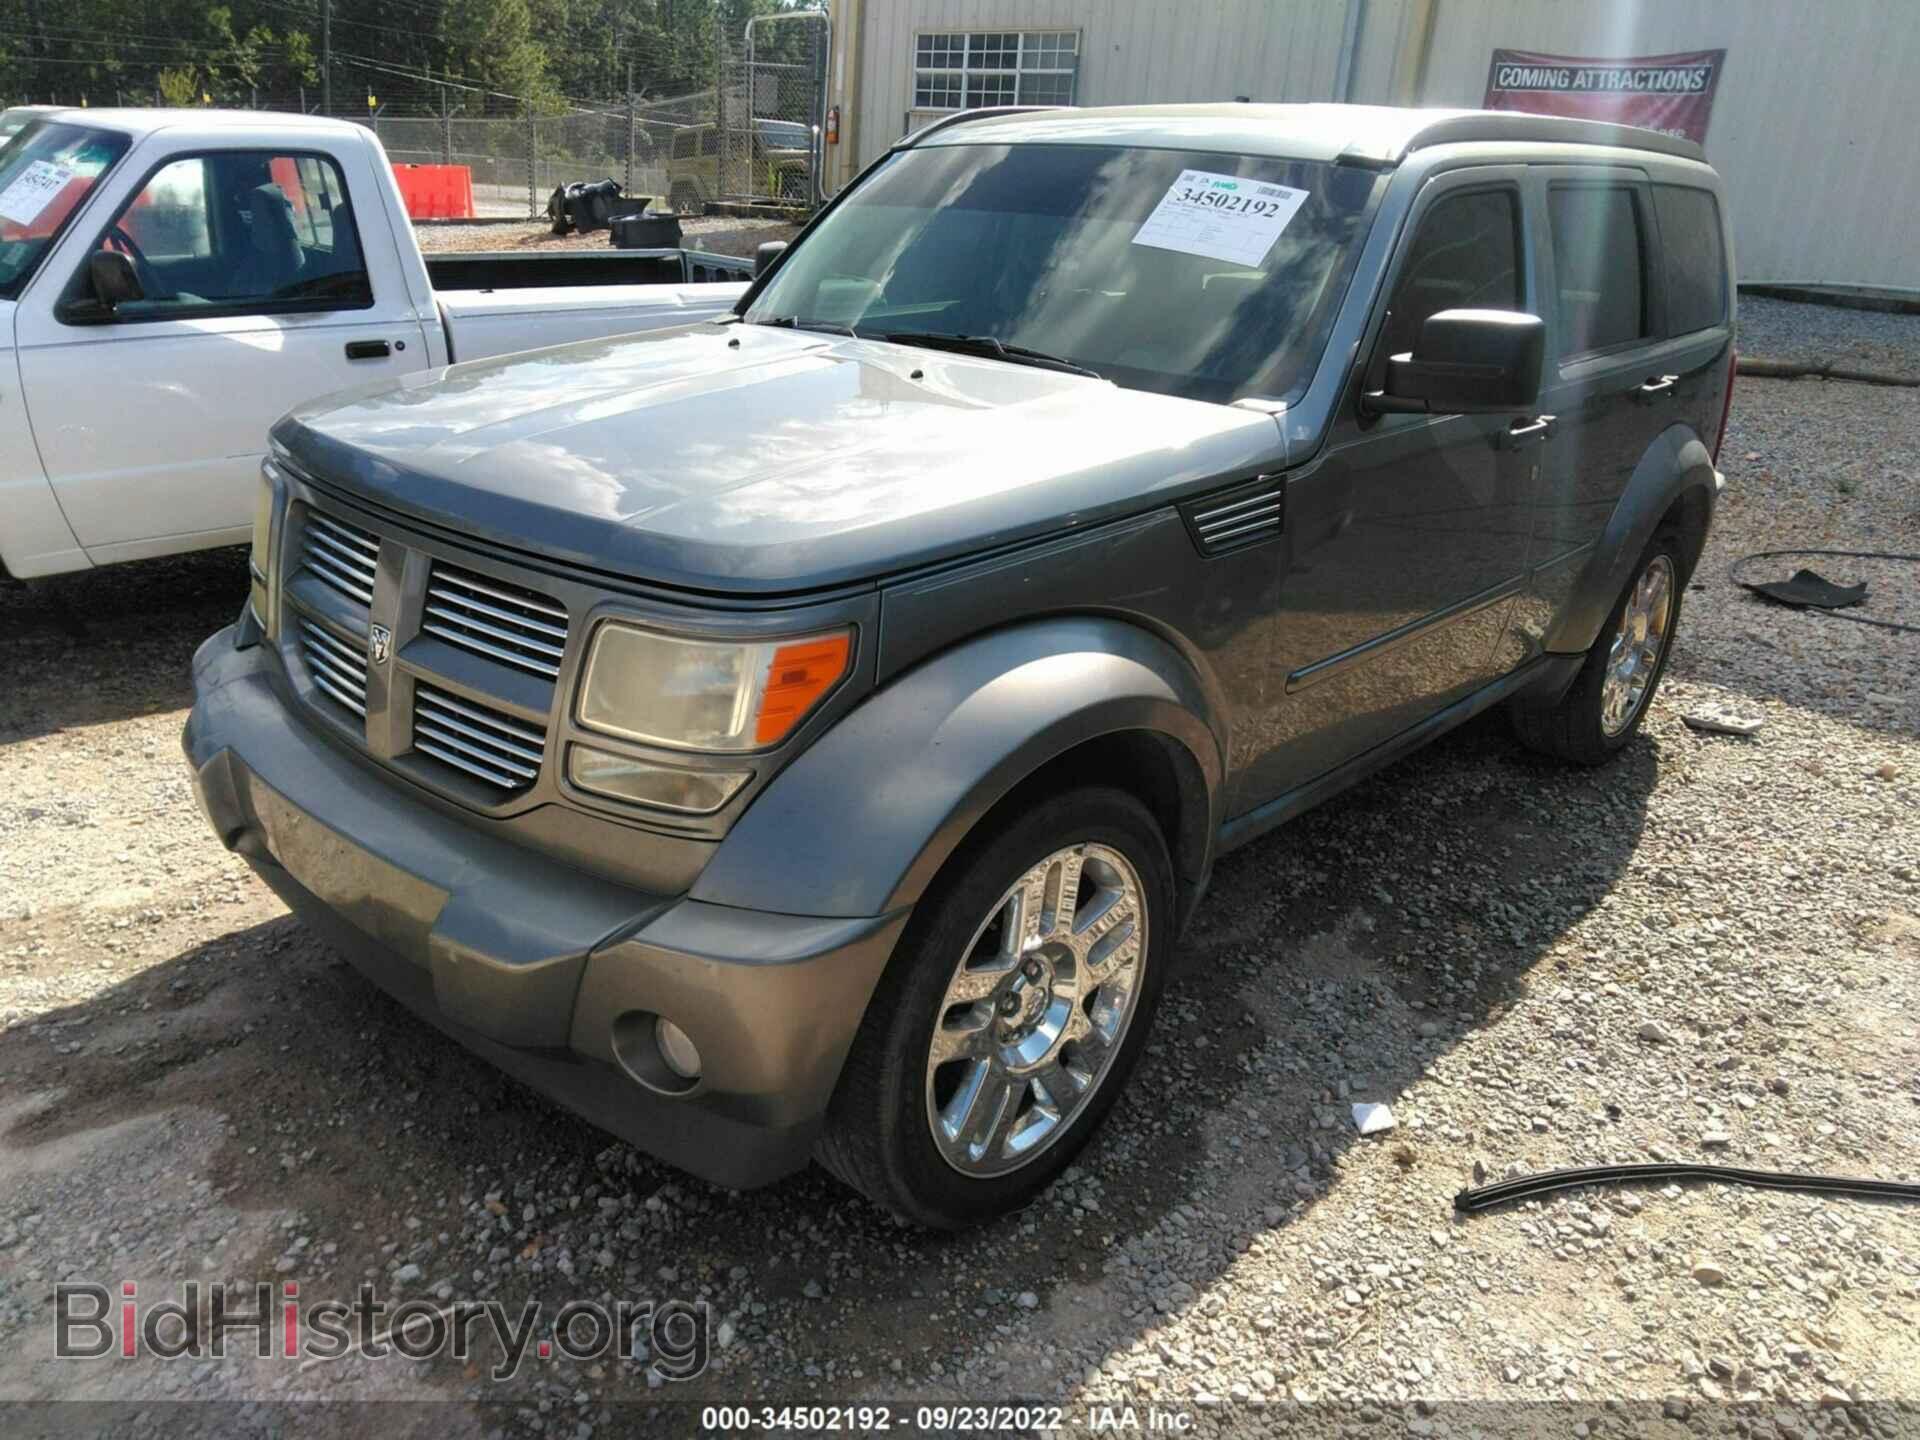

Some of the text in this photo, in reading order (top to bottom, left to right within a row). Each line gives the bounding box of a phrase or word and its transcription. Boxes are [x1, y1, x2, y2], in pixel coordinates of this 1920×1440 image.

[1500, 66, 1705, 90] COMING ATTRACTIONS
[1176, 187, 1280, 218] 34502192
